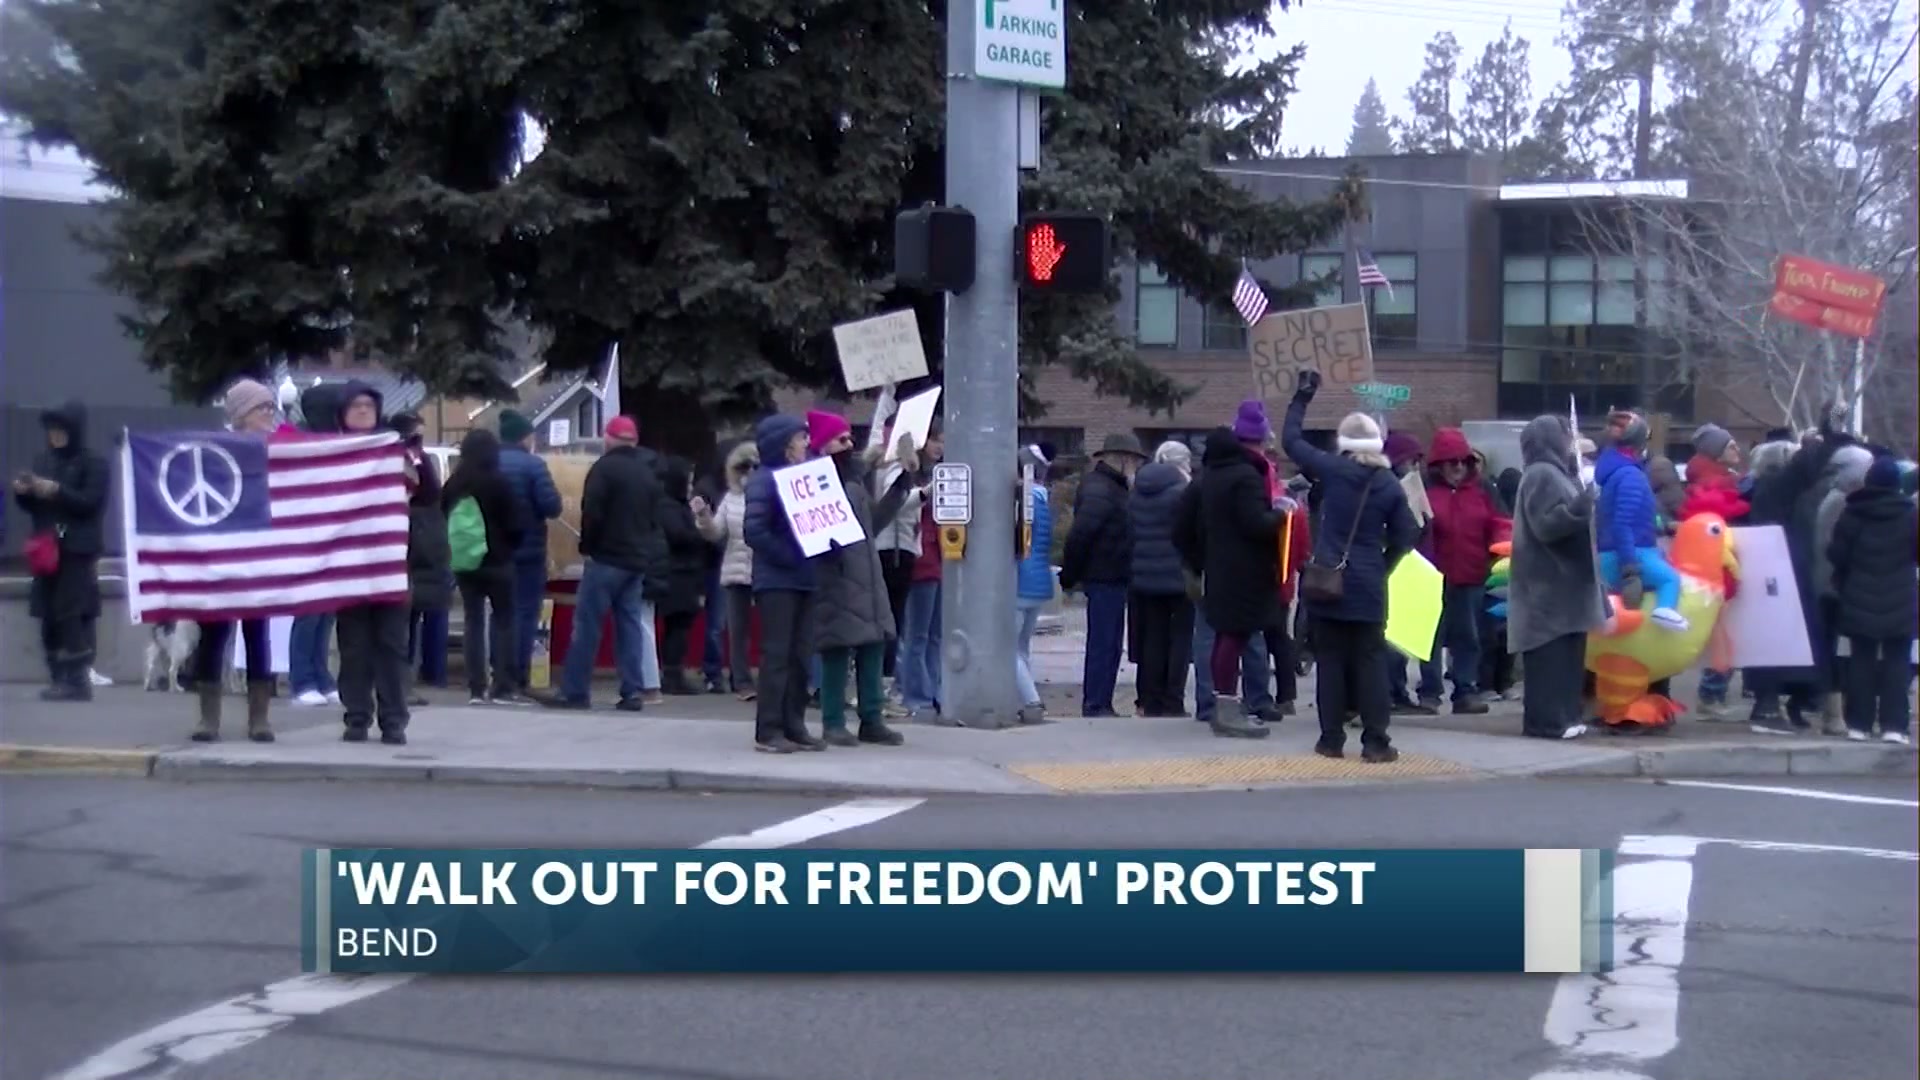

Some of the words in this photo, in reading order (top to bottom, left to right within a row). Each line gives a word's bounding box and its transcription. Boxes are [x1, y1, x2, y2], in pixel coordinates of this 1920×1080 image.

[986, 43, 1053, 69] GARAGE
[1284, 310, 1331, 336] NO
[1254, 328, 1366, 369] SECRET
[1259, 357, 1363, 399] POCE
[790, 474, 815, 502] ICE
[792, 500, 848, 536] MURDERS
